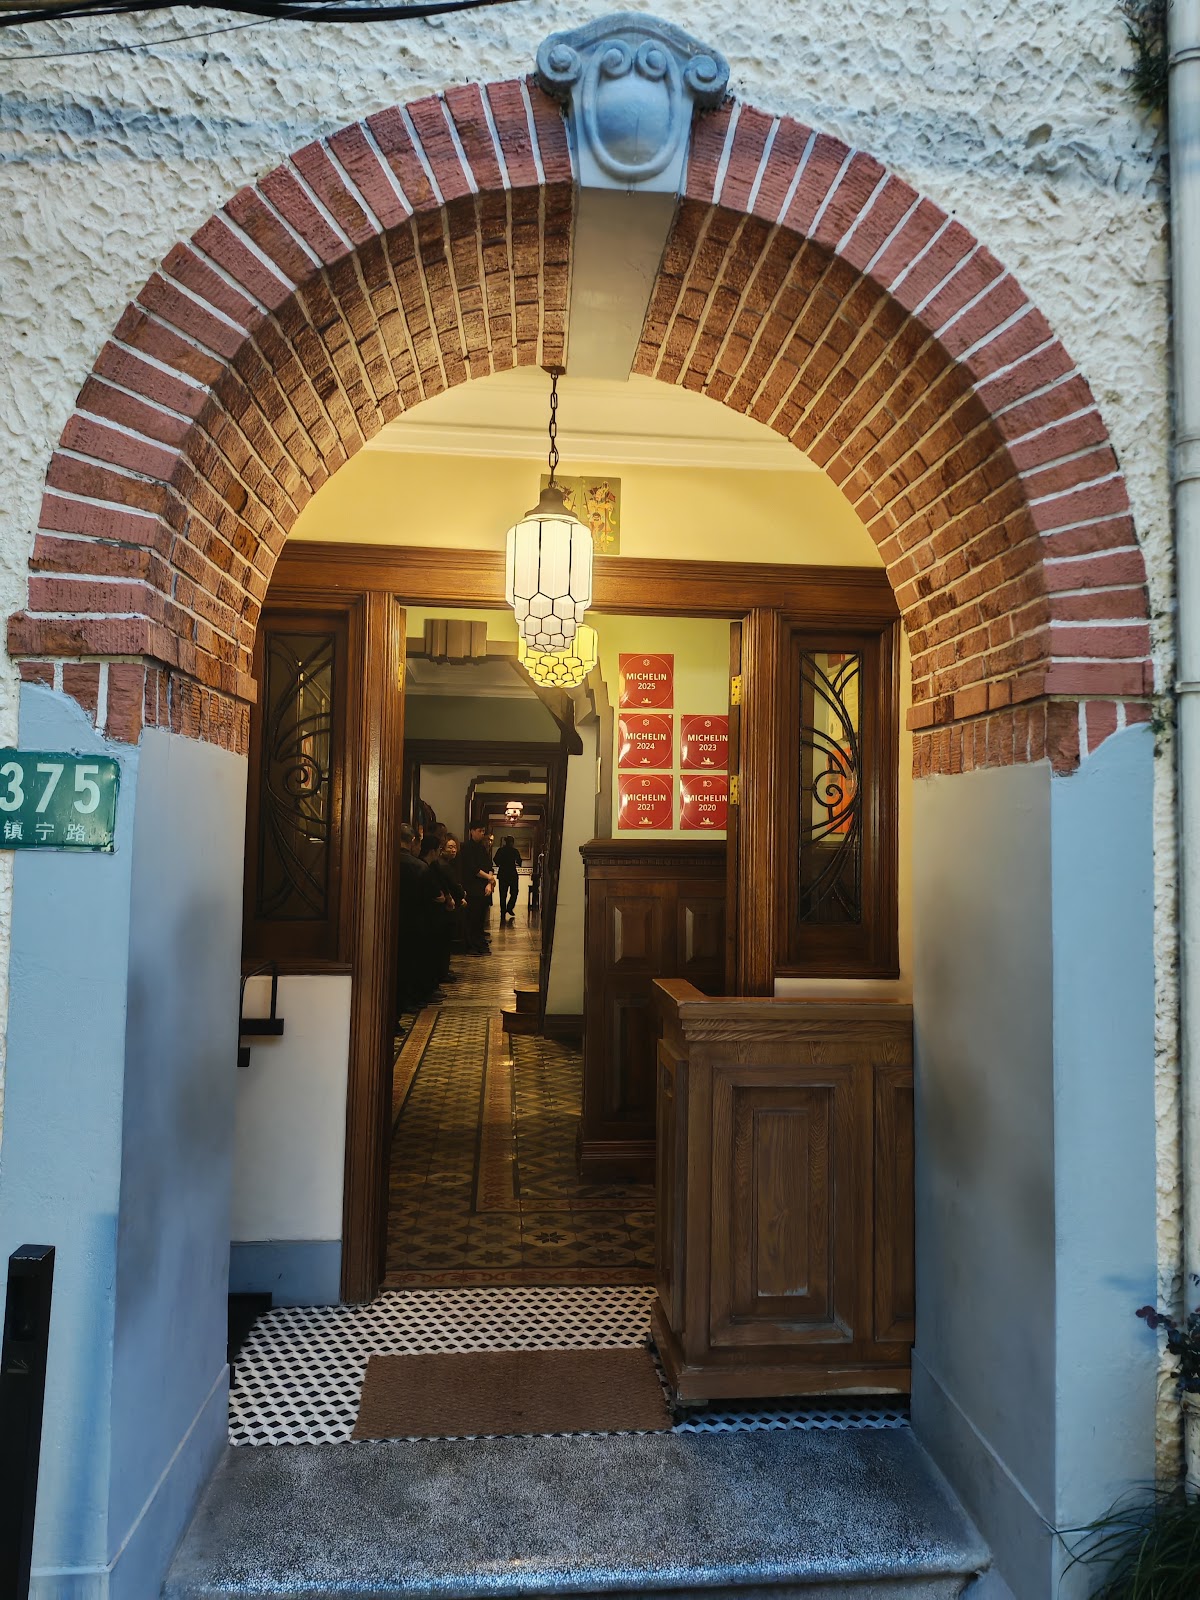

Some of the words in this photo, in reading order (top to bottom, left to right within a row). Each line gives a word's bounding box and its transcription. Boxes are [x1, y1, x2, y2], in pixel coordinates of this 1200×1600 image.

[626, 672, 667, 681] MICHELIN
[637, 682, 656, 690] 2025
[625, 732, 667, 741] MICHELIN
[687, 734, 728, 742] MICHELIN
[636, 742, 655, 750] 2024
[698, 743, 717, 751] 2023
[0, 761, 101, 814] 375
[626, 793, 667, 801] MICHELIN
[688, 793, 728, 802] MICHELIN
[637, 803, 655, 811] 2021
[698, 804, 717, 812] 2020
[3, 820, 86, 842] 镇宁路
